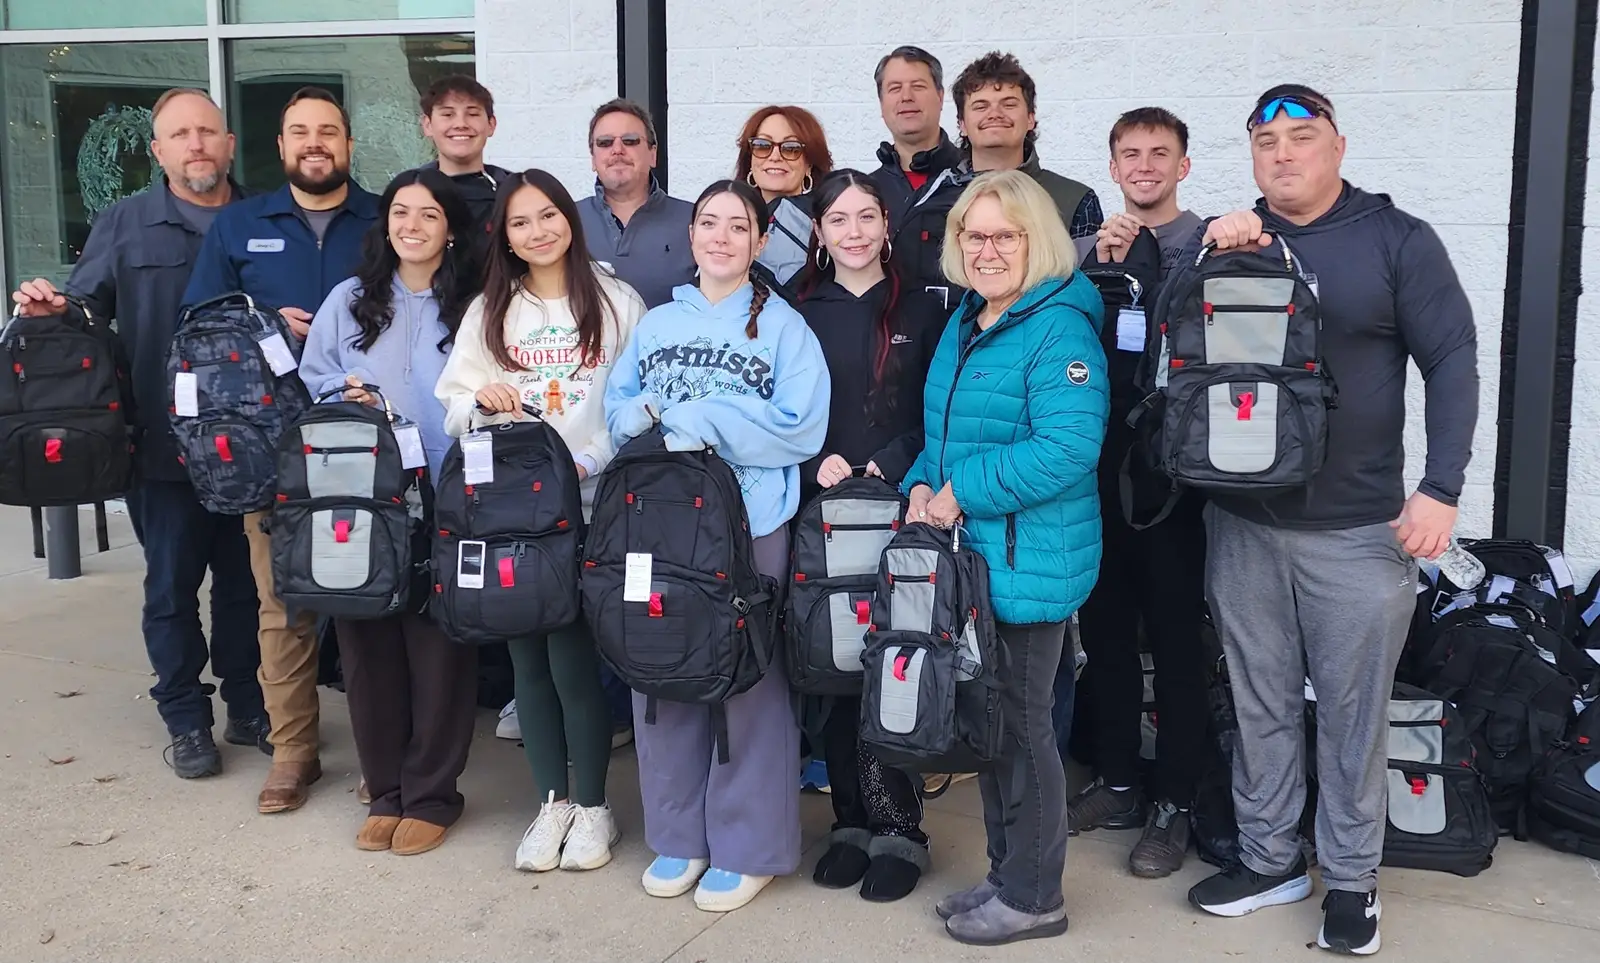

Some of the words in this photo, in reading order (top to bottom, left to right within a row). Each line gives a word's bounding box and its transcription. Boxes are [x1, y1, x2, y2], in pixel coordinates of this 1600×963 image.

[520, 336, 556, 346] NORTH
[519, 374, 543, 385] Fresh
[569, 373, 594, 386] Daily
[714, 380, 748, 395] words
